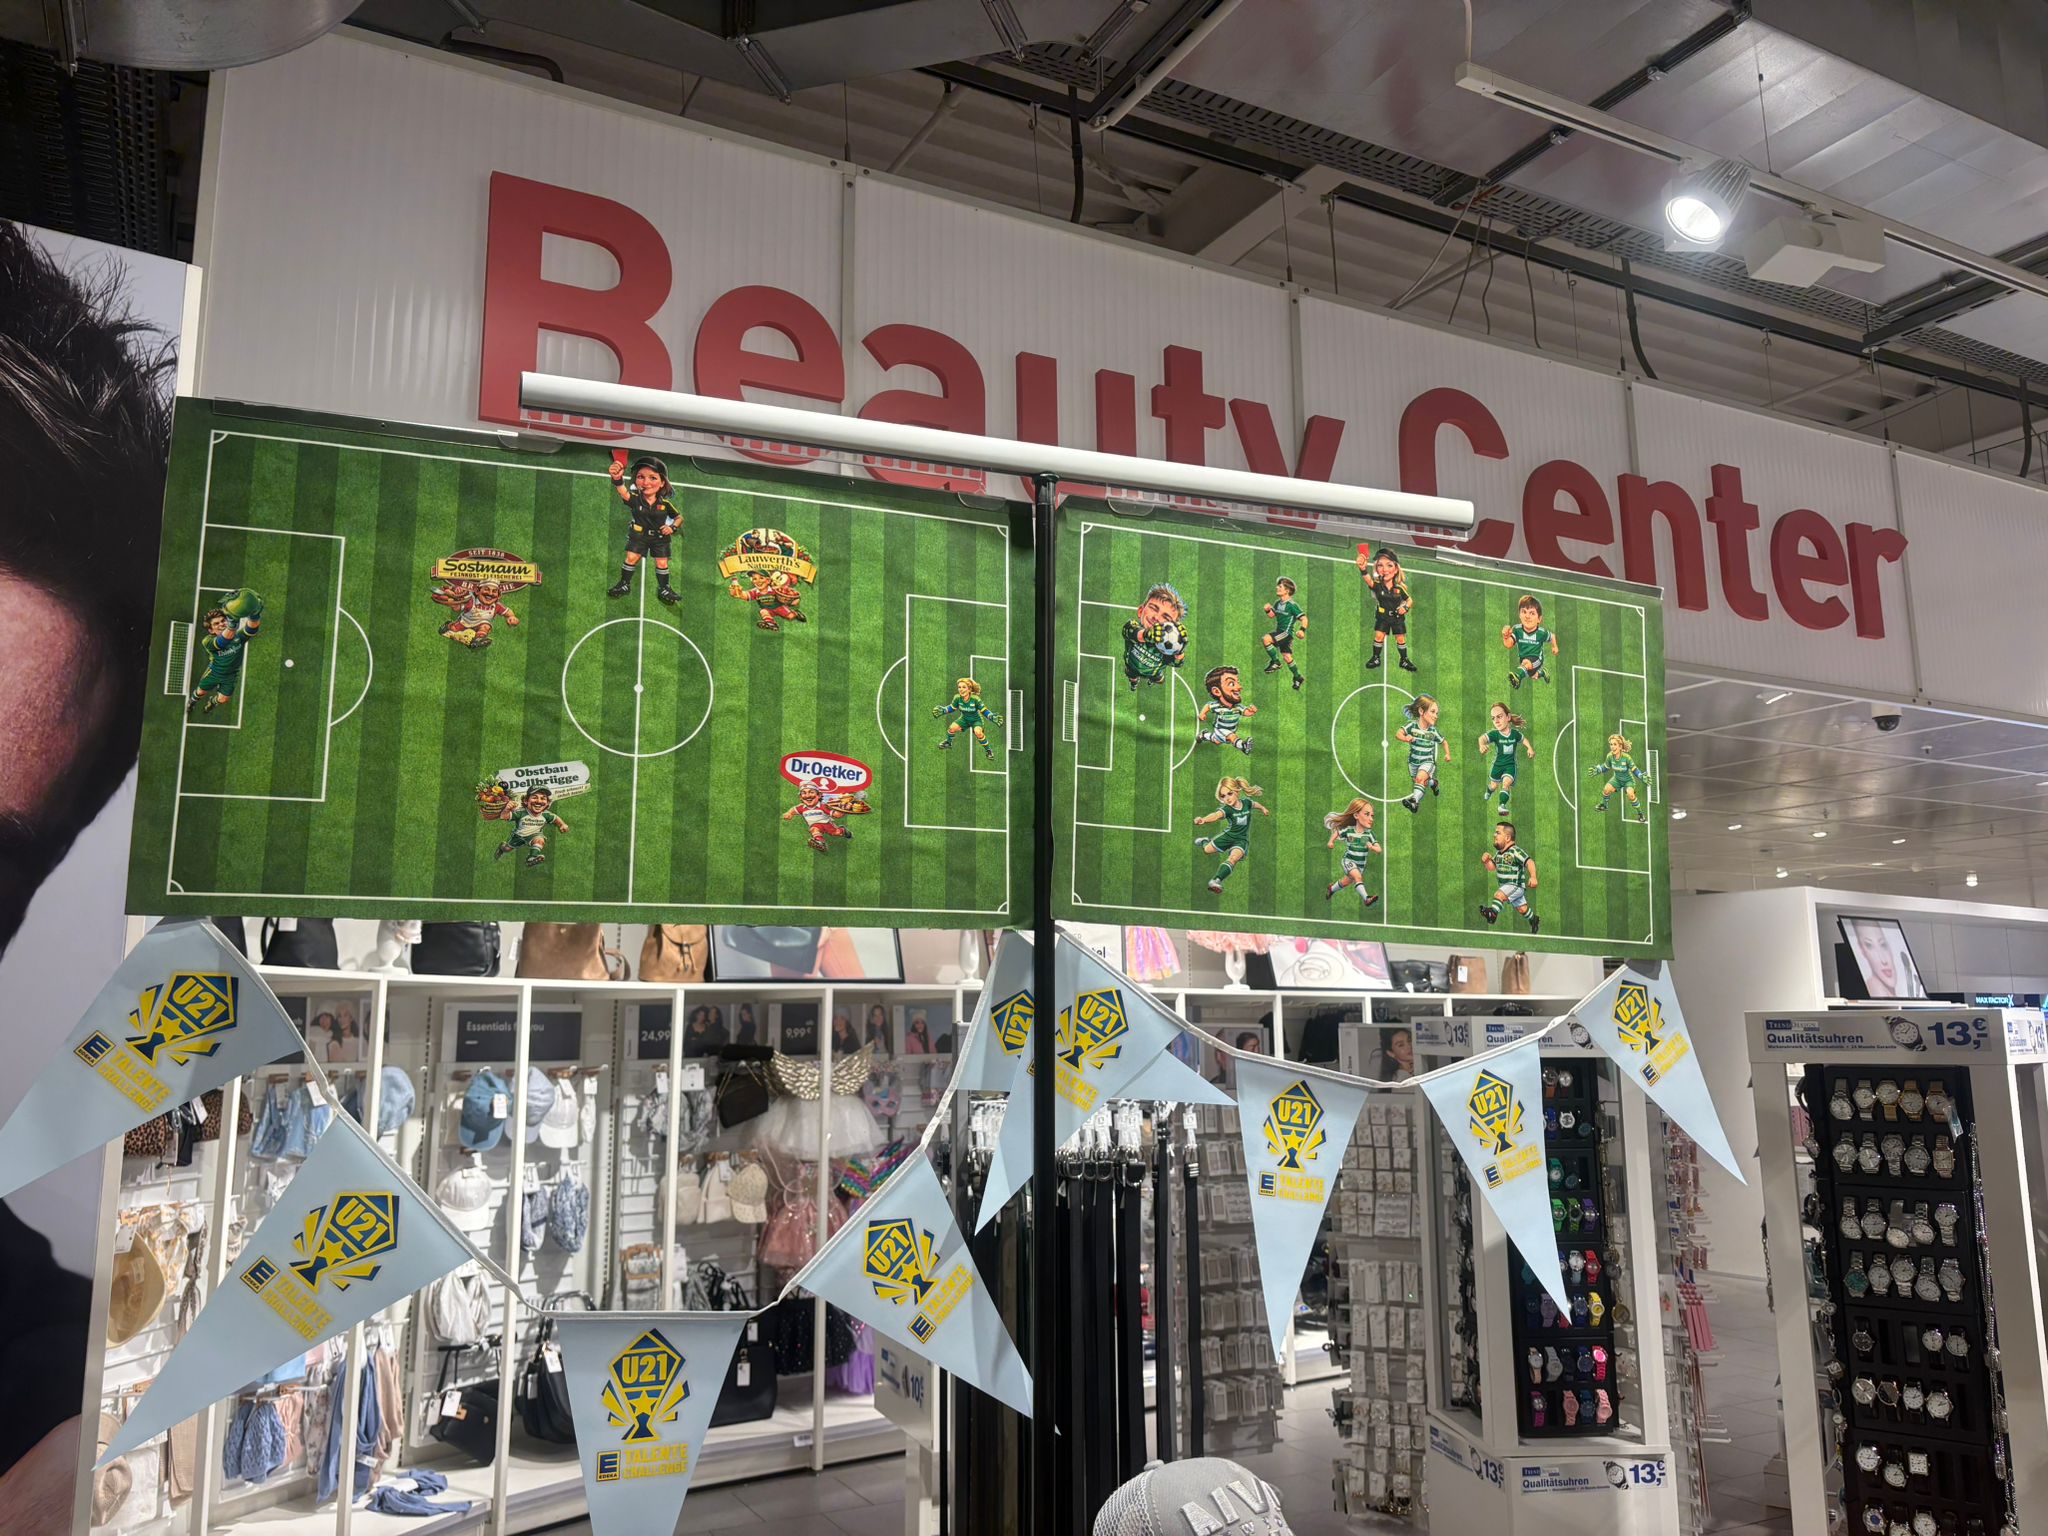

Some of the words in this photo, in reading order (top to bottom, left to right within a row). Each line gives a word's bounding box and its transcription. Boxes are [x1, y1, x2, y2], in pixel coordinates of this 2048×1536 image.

[480, 171, 1346, 529] Beauty
[1399, 387, 1909, 639] Center
[443, 558, 531, 575] Sostmann
[739, 555, 800, 568] Lauwerth's
[509, 774, 579, 789] Dellbrügge
[514, 765, 569, 778] Obstbau
[791, 758, 863, 782] Dr.Oetker
[172, 977, 228, 1027] U21
[1080, 996, 1119, 1034] U21
[1617, 990, 1645, 1023] U21
[466, 1021, 511, 1031] Essentials
[1003, 1003, 1035, 1046] U21
[1767, 1033, 1864, 1044] Qualitätsuhren
[97, 1063, 158, 1114] CHALLENGE
[109, 1050, 172, 1104] TALENTE
[1278, 1099, 1312, 1125] U21
[1474, 1085, 1507, 1116] U21
[335, 1197, 388, 1249] U21
[868, 1228, 910, 1274] U21
[273, 1275, 334, 1329] TALENTE
[621, 1353, 668, 1384] U21
[624, 1443, 689, 1464] TALENTE
[623, 1461, 689, 1479] CHALLENGE
[1523, 1477, 1589, 1488] Qualitätsuhren
